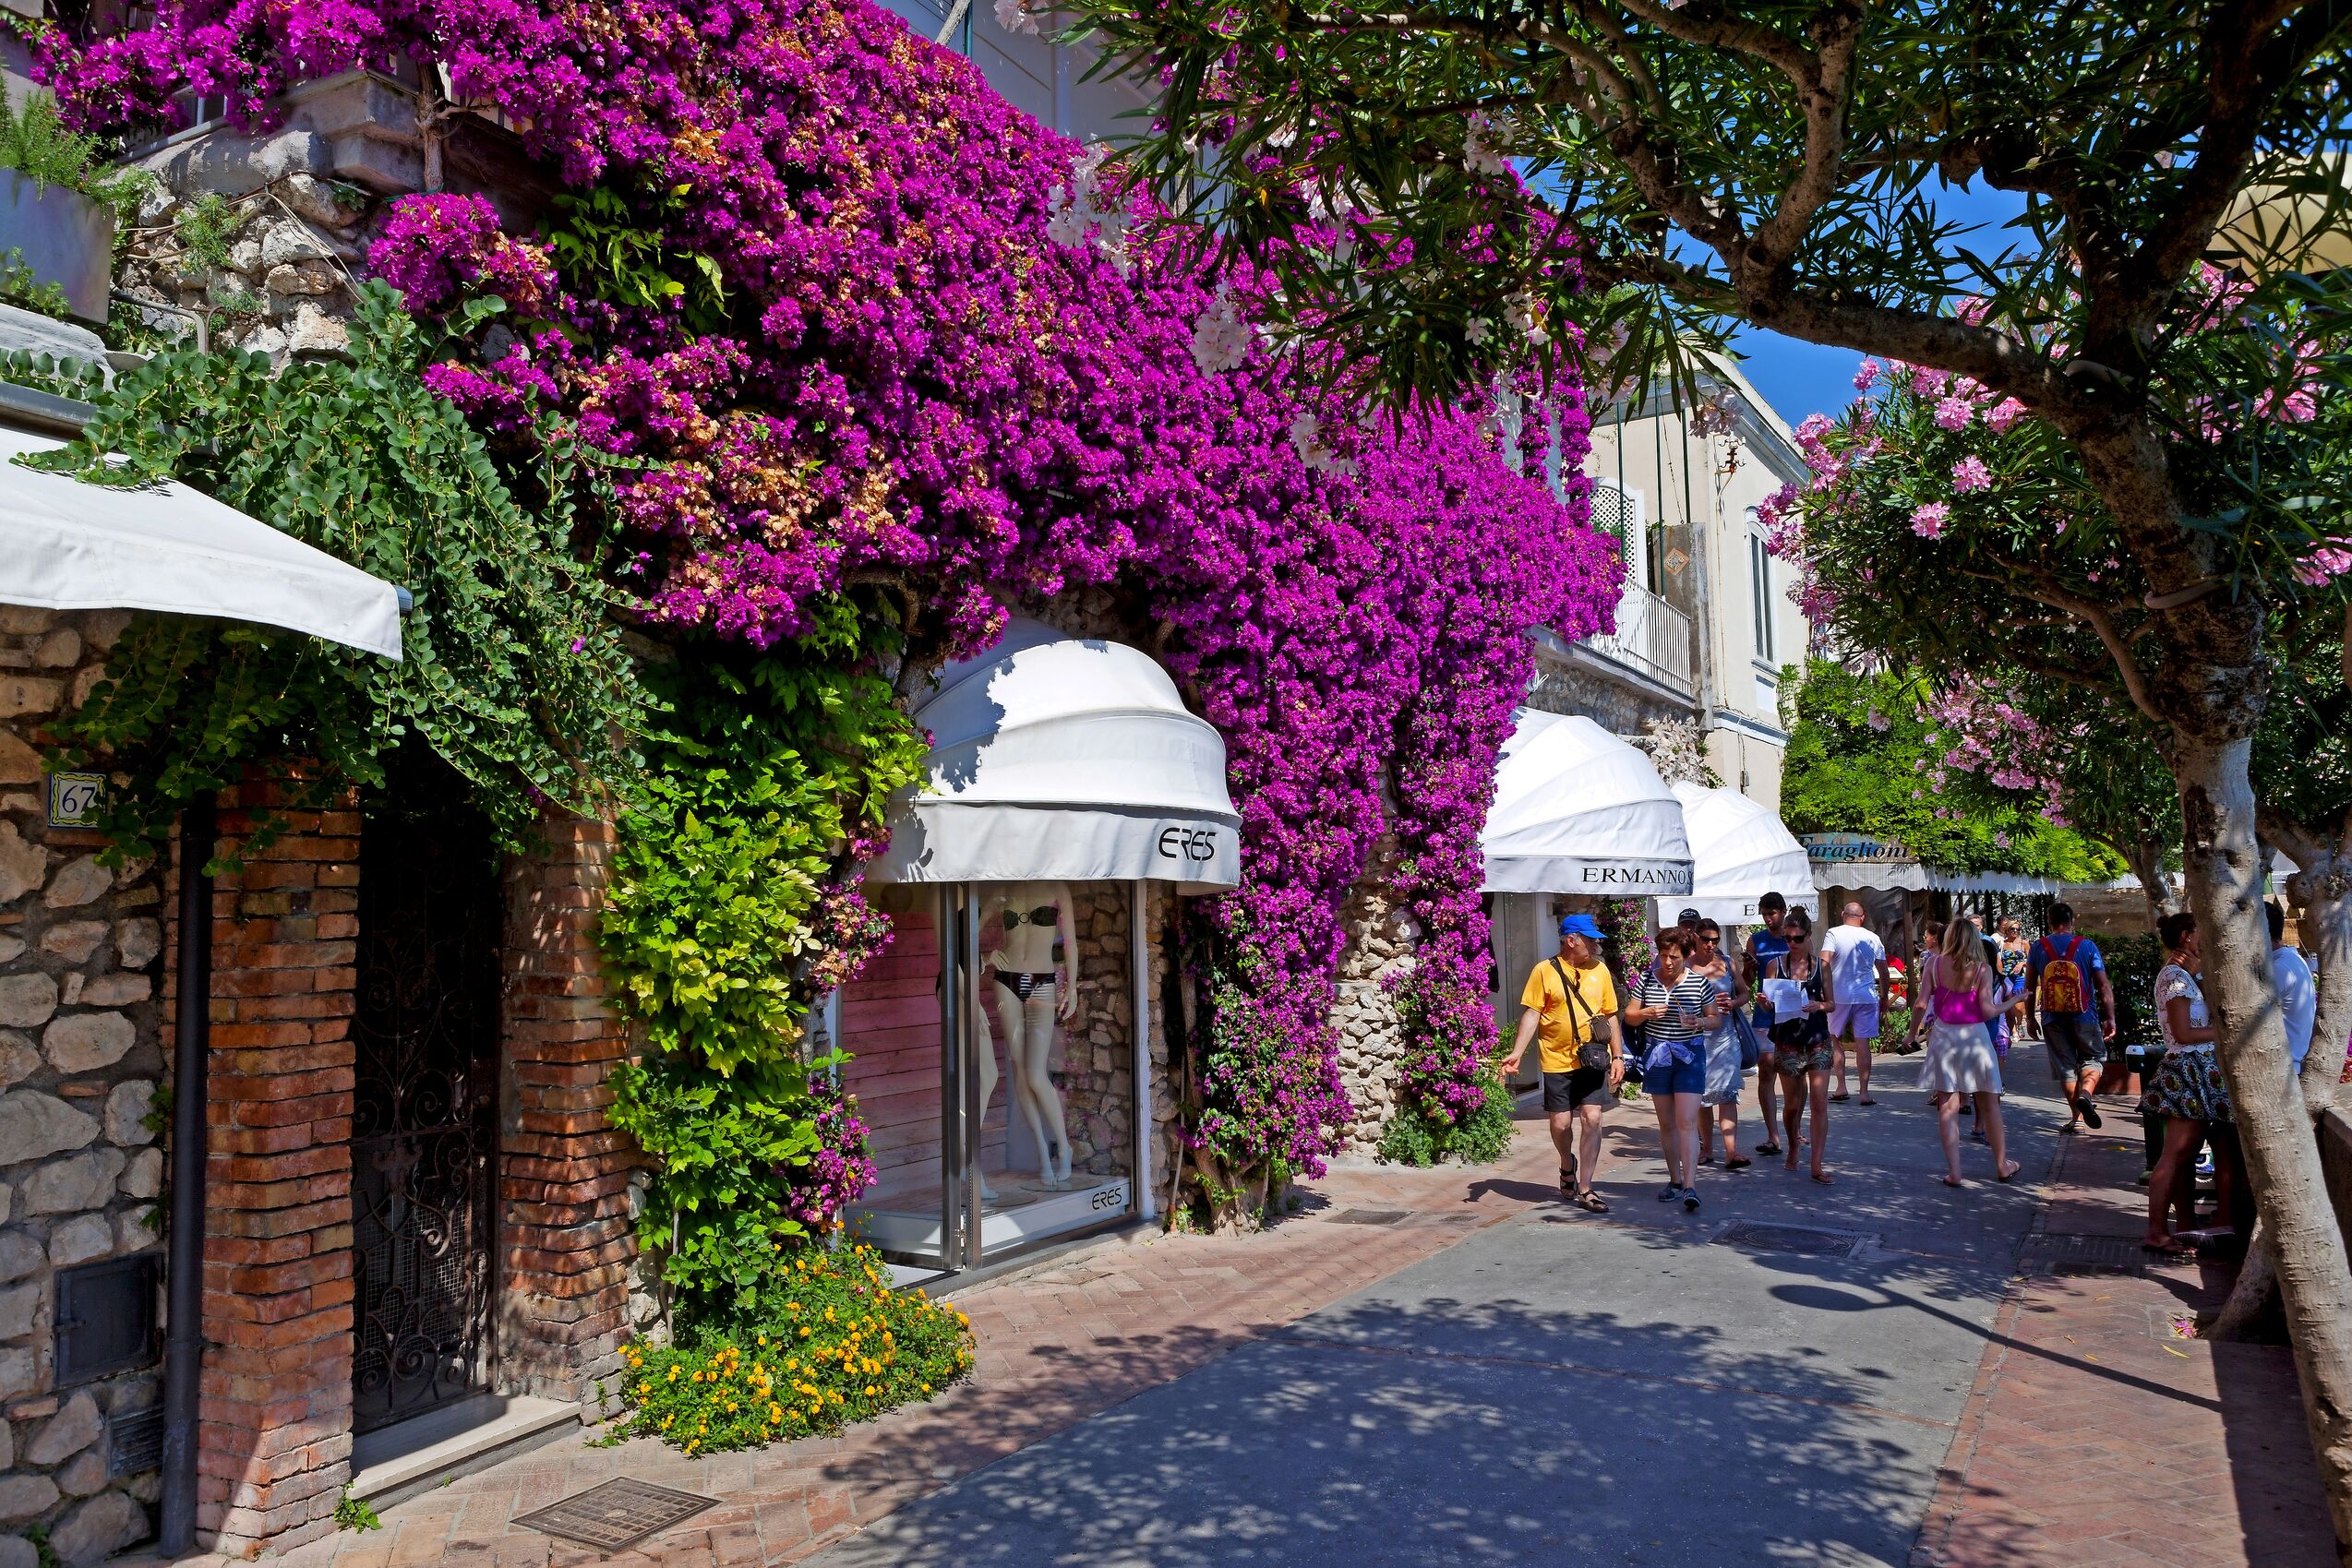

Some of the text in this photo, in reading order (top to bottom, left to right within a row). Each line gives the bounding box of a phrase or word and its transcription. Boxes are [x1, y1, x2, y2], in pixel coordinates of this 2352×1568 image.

[62, 784, 95, 813] 67
[1158, 827, 1217, 861] ERES
[1581, 867, 1686, 885] ERMANNO
[1092, 1187, 1122, 1210] ERES
